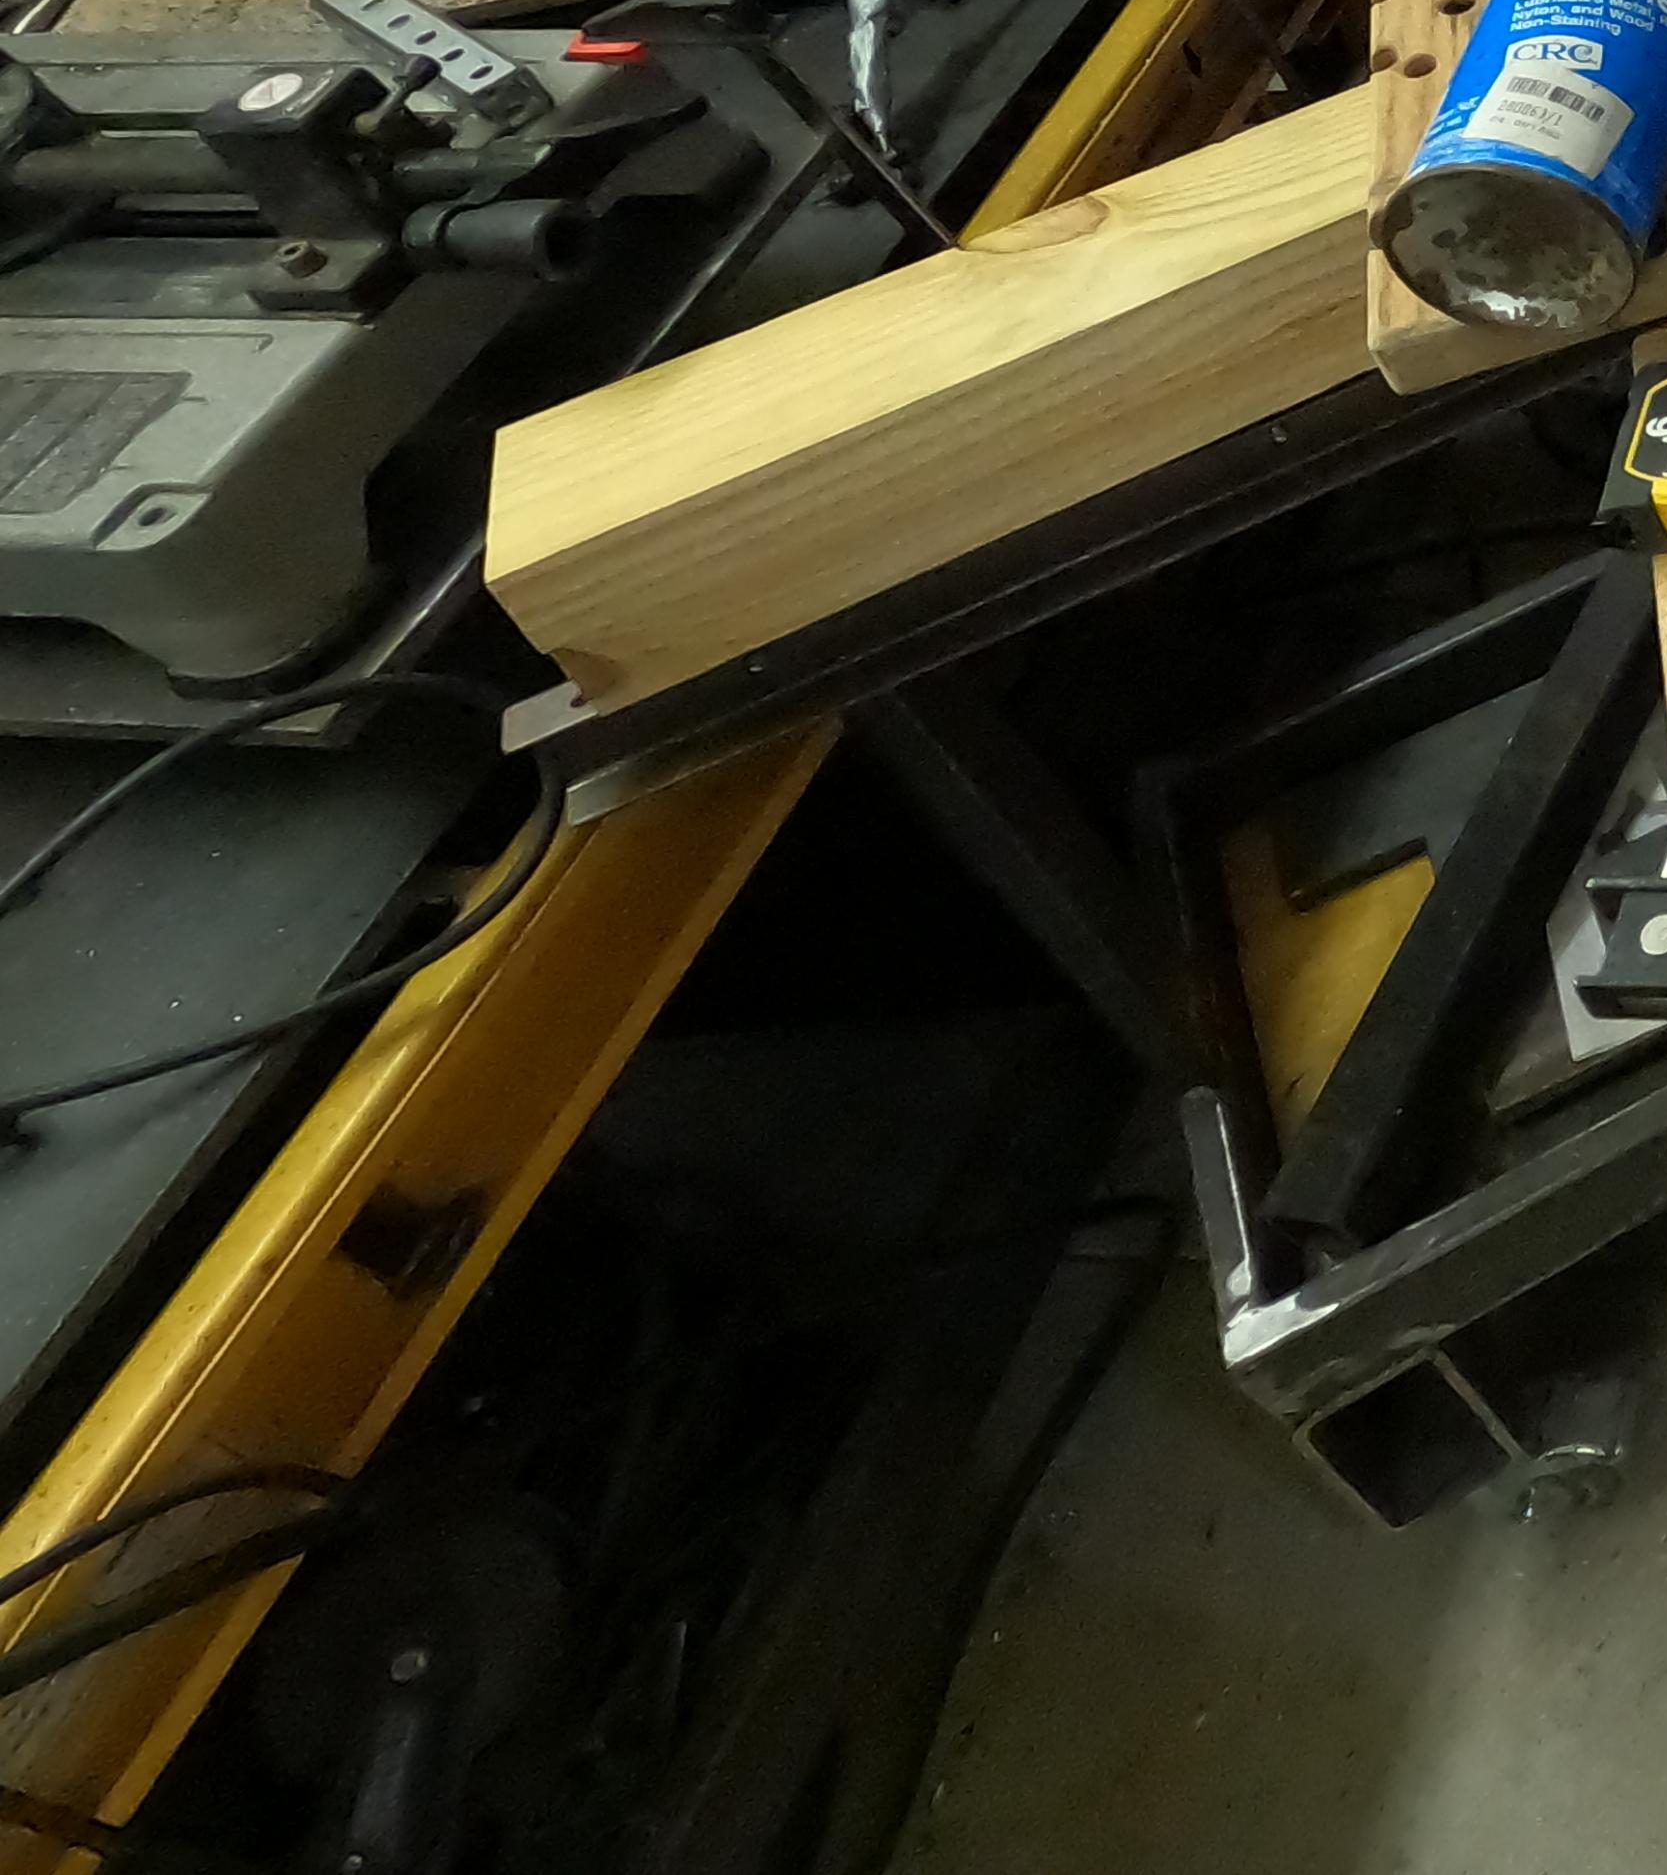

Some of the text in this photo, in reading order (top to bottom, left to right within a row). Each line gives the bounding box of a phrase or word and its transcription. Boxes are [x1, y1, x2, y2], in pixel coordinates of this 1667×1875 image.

[1510, 15, 1622, 36] Non-Staining
[1571, 3, 1604, 16] and
[1609, 8, 1655, 32] Wood
[1513, 42, 1594, 63] CRC
